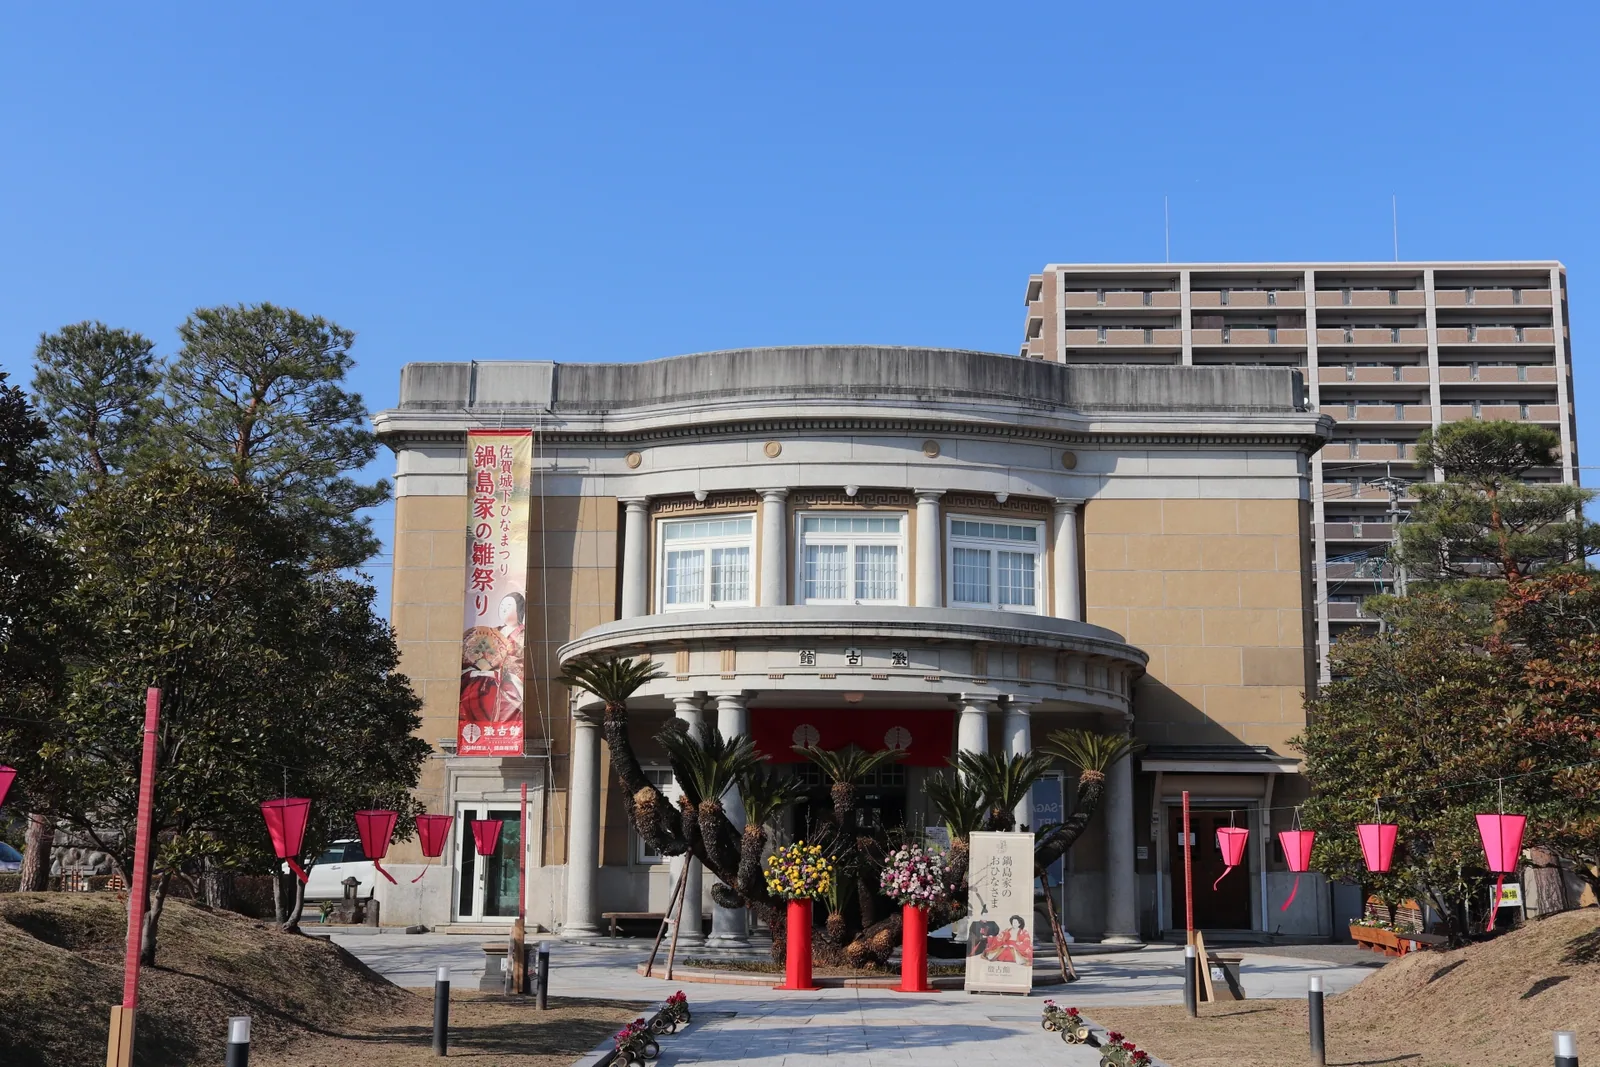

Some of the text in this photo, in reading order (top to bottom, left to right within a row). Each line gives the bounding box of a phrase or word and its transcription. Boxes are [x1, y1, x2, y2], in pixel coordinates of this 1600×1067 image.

[472, 445, 496, 616] 鍋島家の雛祭り
[500, 445, 512, 576] 佐賀城下ひなまつり
[990, 856, 1000, 908] おひなさま
[1002, 856, 1012, 897] 鍋島家の
